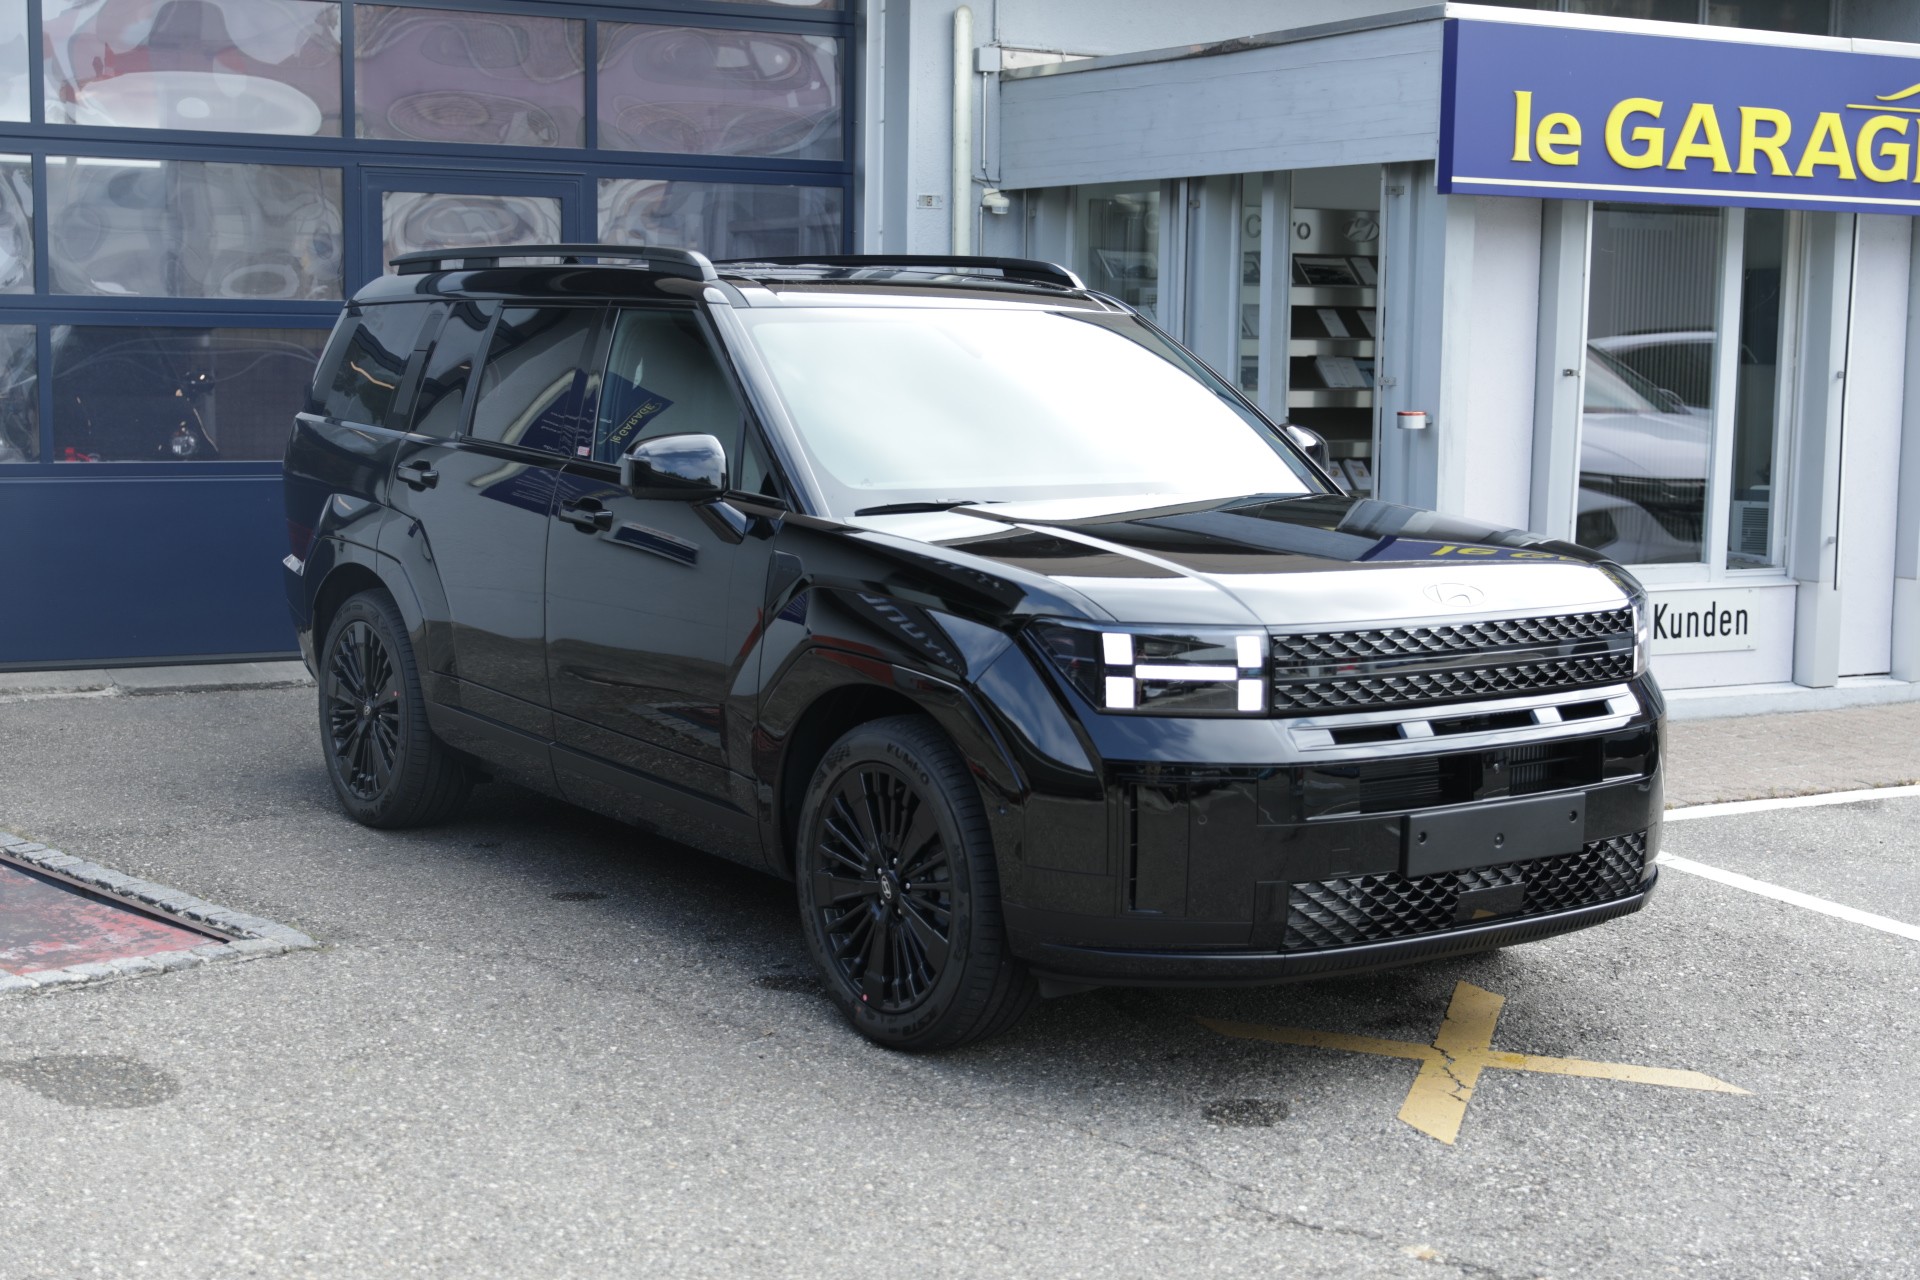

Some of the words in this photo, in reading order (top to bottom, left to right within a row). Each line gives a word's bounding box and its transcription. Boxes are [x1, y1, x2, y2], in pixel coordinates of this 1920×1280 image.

[1511, 90, 1582, 166] le
[1604, 97, 1920, 184] GARAG
[1654, 601, 1748, 640] Kunden
